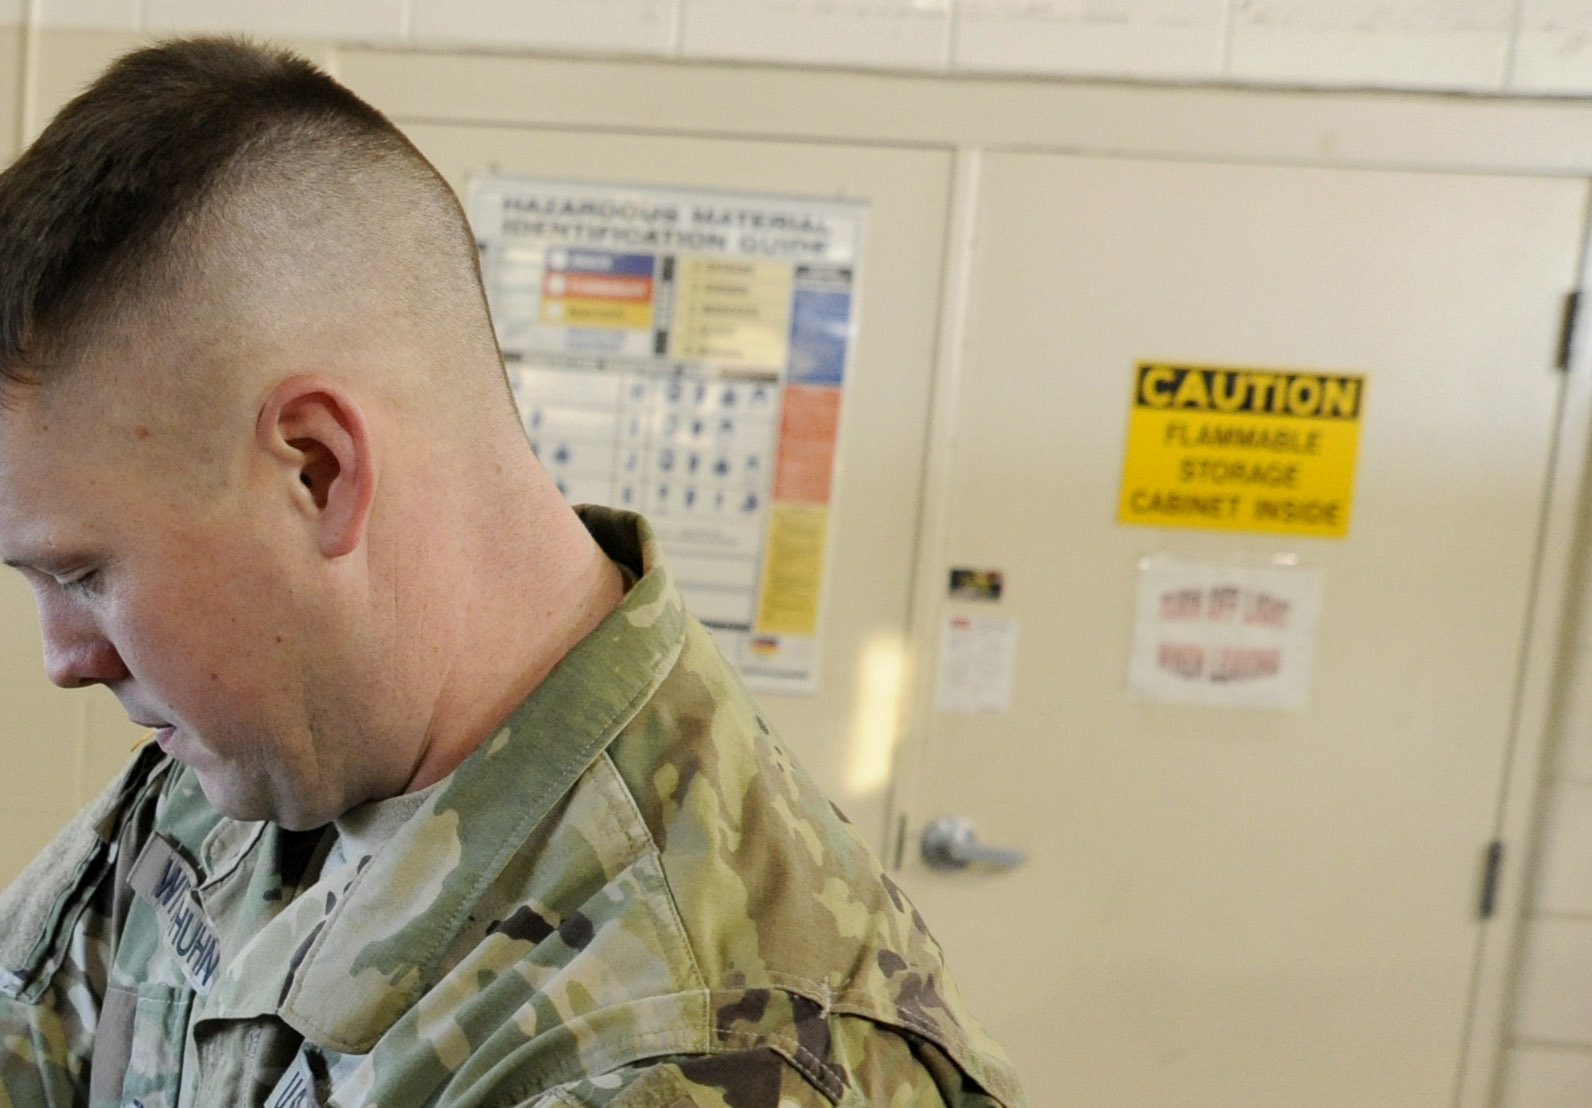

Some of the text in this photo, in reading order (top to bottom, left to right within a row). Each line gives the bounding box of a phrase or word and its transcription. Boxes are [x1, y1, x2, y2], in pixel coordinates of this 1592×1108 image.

[1141, 368, 1358, 417] CAUTION
[1165, 423, 1322, 456] FLAMMABLE
[1180, 459, 1300, 489] STORAGE
[1130, 490, 1341, 526] CABINET INSIDE
